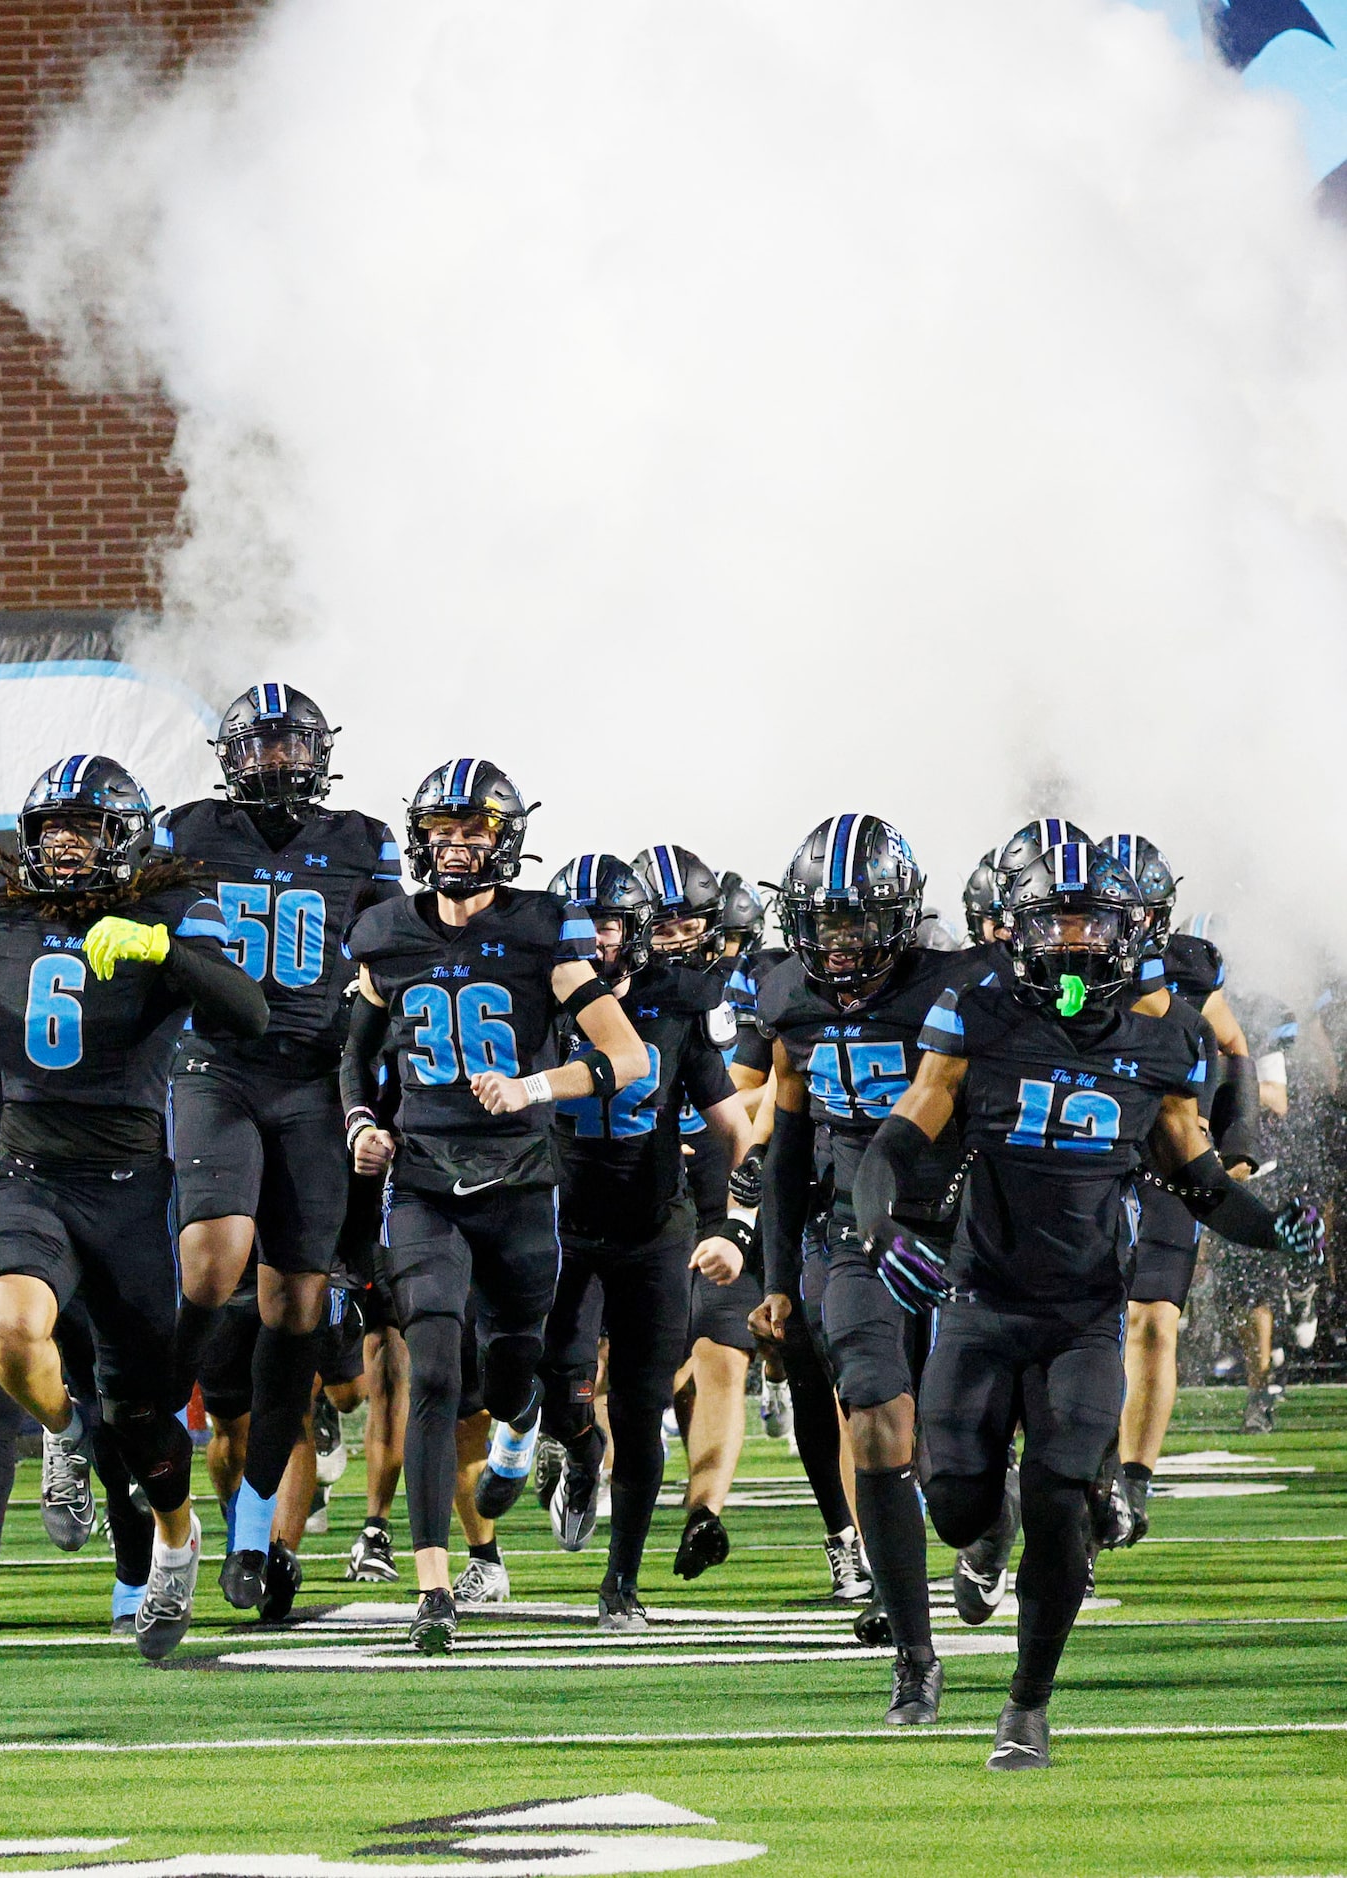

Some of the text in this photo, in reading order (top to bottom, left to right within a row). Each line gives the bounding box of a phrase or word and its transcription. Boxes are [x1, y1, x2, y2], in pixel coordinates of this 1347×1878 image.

[253, 868, 293, 882] The Hill
[43, 935, 61, 948] The
[217, 881, 326, 989] 50
[432, 965, 470, 979] The Hill
[24, 952, 87, 1071] 6
[402, 981, 521, 1086] 36
[823, 1025, 861, 1038] The Hill
[1051, 1069, 1097, 1088] The Hill
